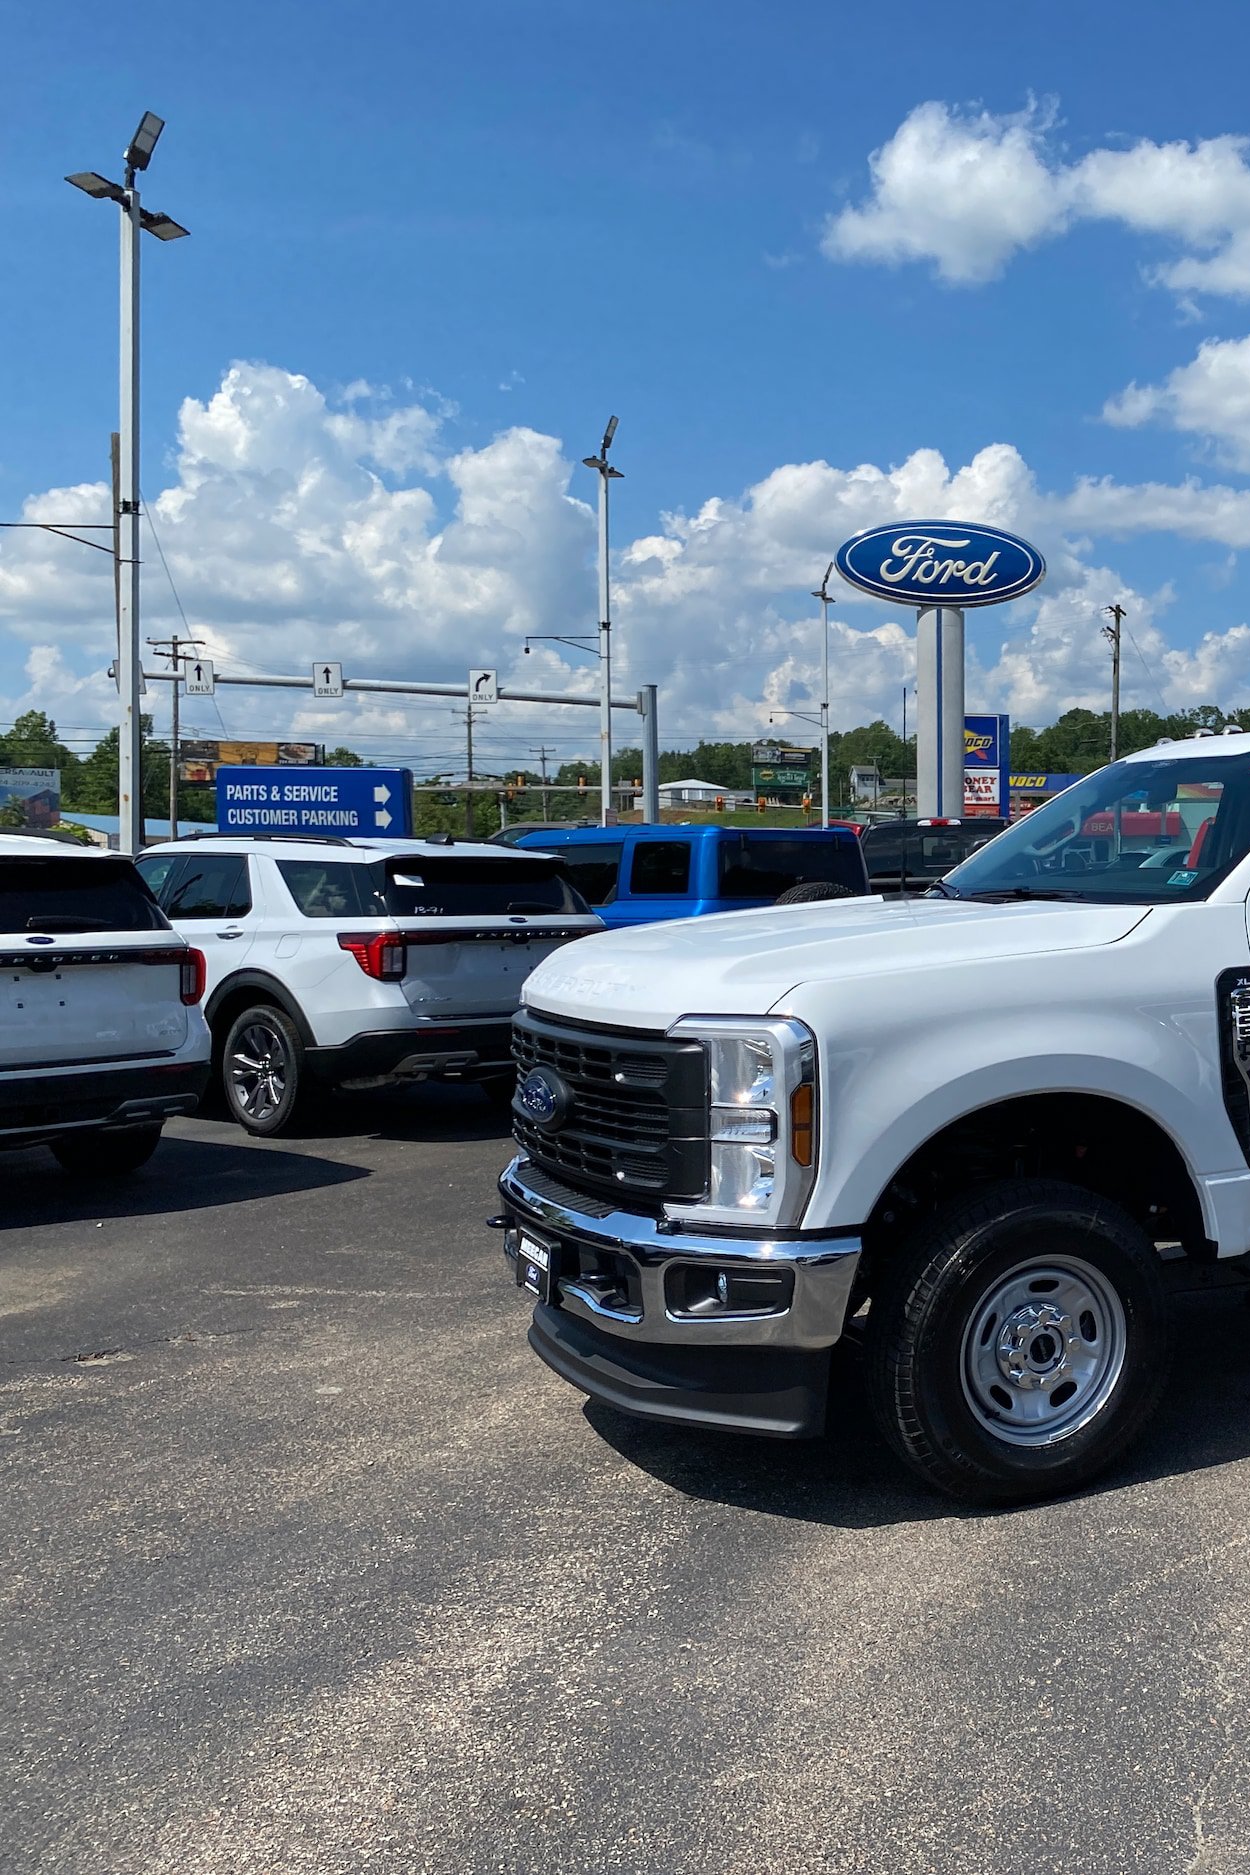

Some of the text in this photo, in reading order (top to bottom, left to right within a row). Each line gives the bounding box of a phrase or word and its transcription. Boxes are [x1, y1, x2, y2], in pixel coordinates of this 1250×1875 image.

[880, 535, 1001, 585] Ford
[318, 687, 339, 695] ONLY
[226, 785, 339, 802] PARTS & SERVICE
[228, 809, 359, 826] CUSTOMER PARKING
